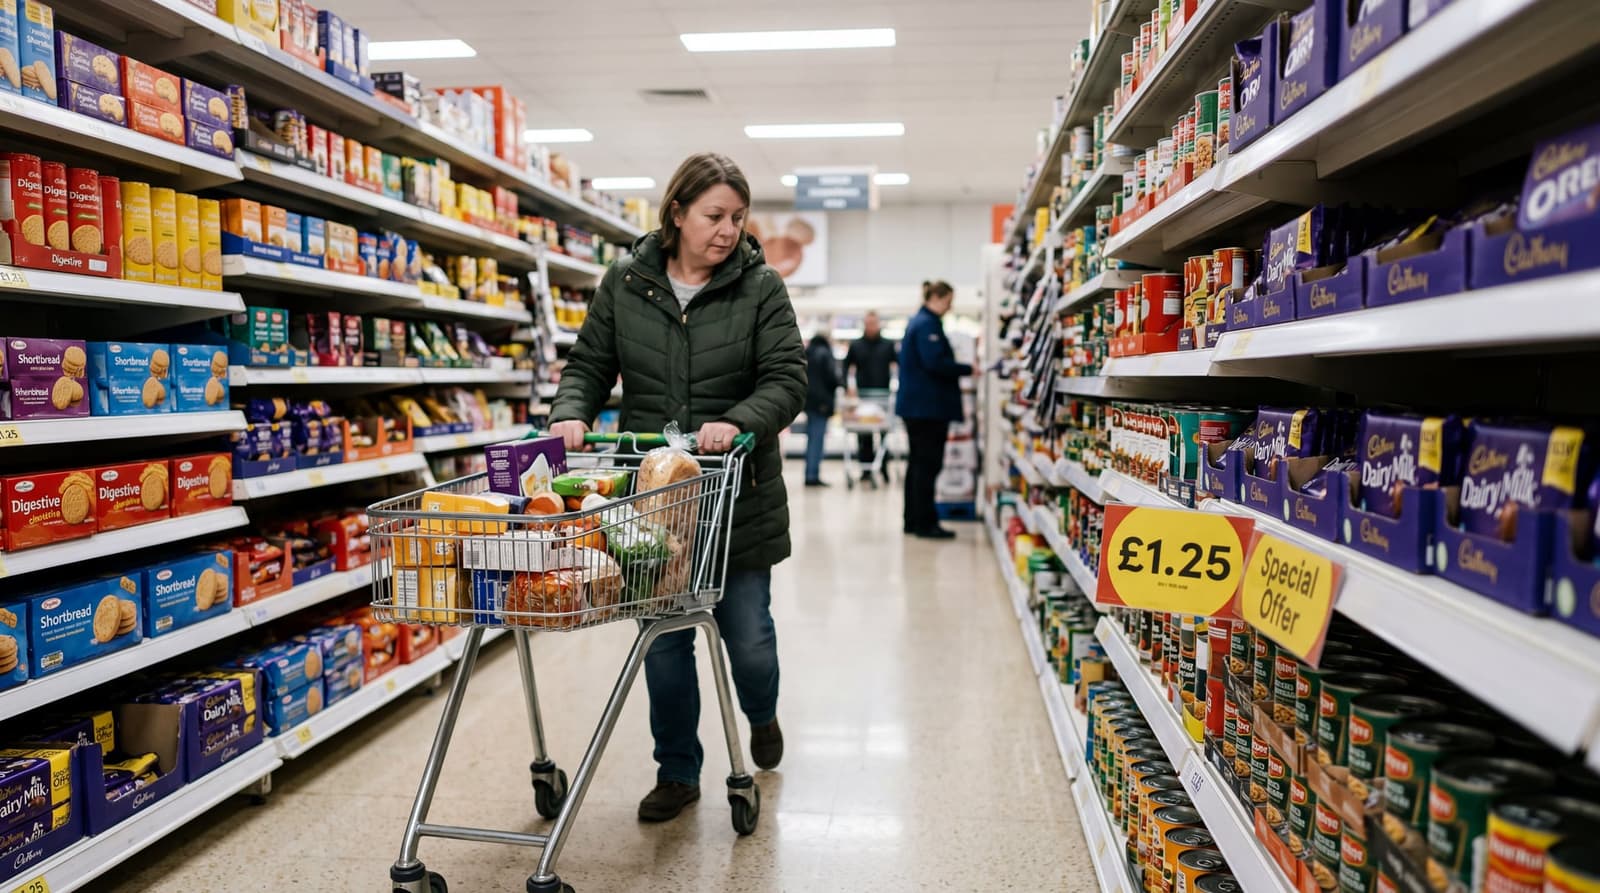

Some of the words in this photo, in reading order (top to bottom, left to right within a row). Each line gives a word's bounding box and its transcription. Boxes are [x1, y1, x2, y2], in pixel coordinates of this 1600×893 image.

[1241, 75, 1261, 109] OR
[1527, 155, 1600, 220] ORE
[52, 253, 83, 268] Digestive
[1504, 232, 1568, 276] Cadbury
[1267, 261, 1284, 283] Dairy
[1388, 263, 1429, 296] Cadbury
[1254, 441, 1275, 464] Dairy
[1362, 461, 1392, 492] Dairy
[11, 495, 60, 515] Digestive
[99, 483, 140, 502] Digestive
[1460, 476, 1501, 514] Dairy
[1118, 536, 1231, 581] £1.25
[1261, 547, 1320, 600] Special
[155, 575, 196, 597] Shortbread
[40, 603, 92, 629] Shortbread
[1259, 588, 1300, 636] Offer
[204, 703, 227, 721] Dairy
[0, 796, 24, 819] airy
[24, 782, 49, 807] Milk
[13, 848, 44, 870] Cadbury
